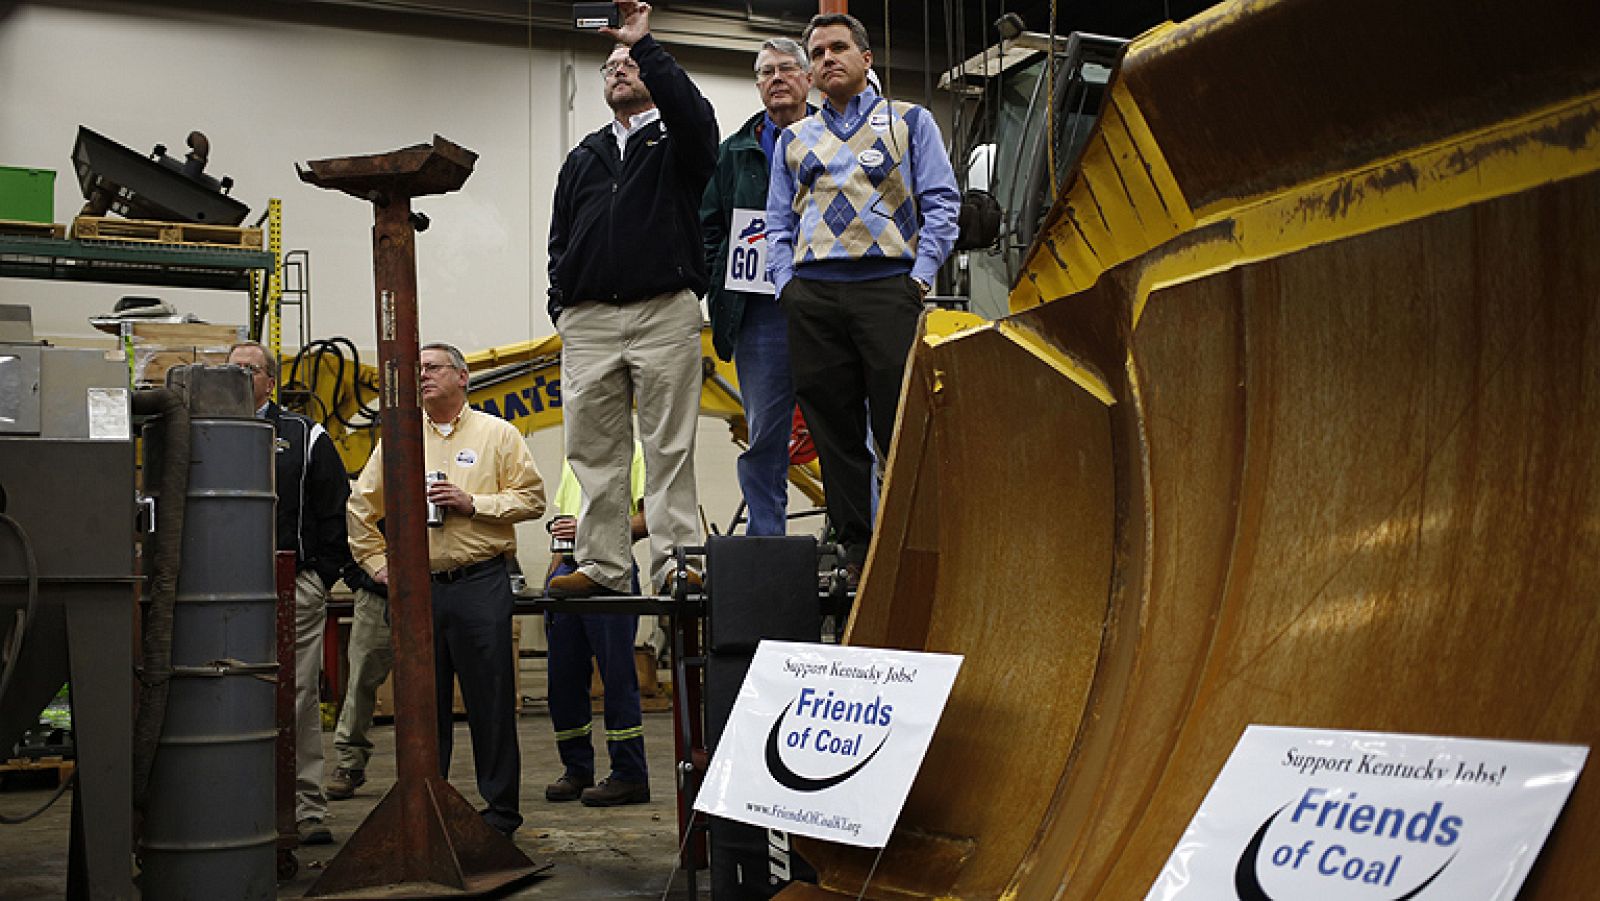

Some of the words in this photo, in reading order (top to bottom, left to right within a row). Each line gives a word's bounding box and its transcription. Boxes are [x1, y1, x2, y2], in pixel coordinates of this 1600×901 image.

[731, 246, 758, 281] GO
[783, 659, 827, 678] Support
[830, 661, 881, 684] Kentucky
[882, 666, 917, 684] Jobs!
[796, 687, 893, 726] Friends
[787, 727, 812, 749] of
[815, 729, 862, 756] Coal
[1282, 747, 1352, 776] Support
[1357, 753, 1449, 781] Kentucky
[1453, 760, 1507, 786] Jobs!
[1290, 787, 1463, 847] Friends
[1272, 840, 1315, 870] of
[1317, 844, 1402, 887] Coal
